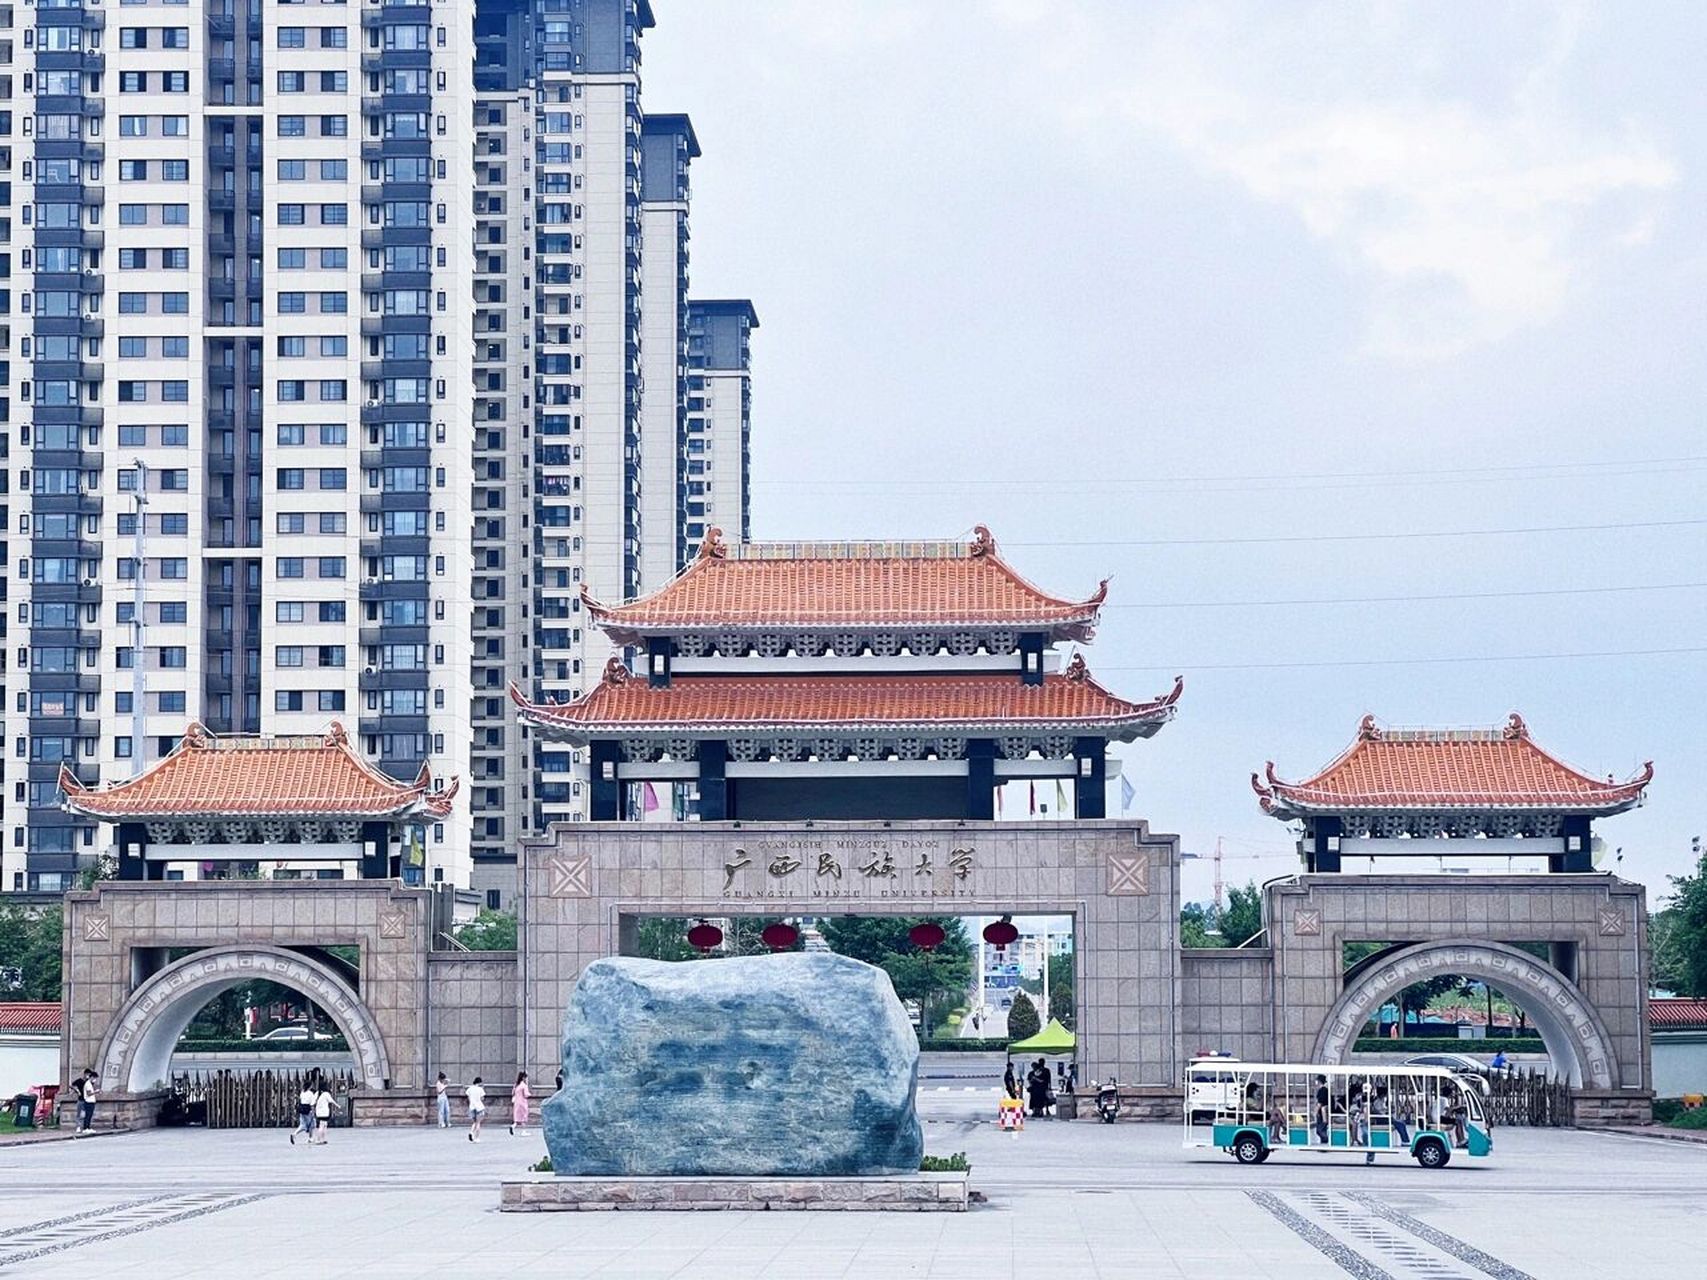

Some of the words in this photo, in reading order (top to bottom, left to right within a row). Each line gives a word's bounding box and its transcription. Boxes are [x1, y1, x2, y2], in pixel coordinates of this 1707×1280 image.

[723, 847, 976, 891] 广西民族大学
[723, 890, 795, 899] GUANGXI
[813, 890, 861, 898] MINZU
[881, 890, 976, 898] UNIVERSITY
